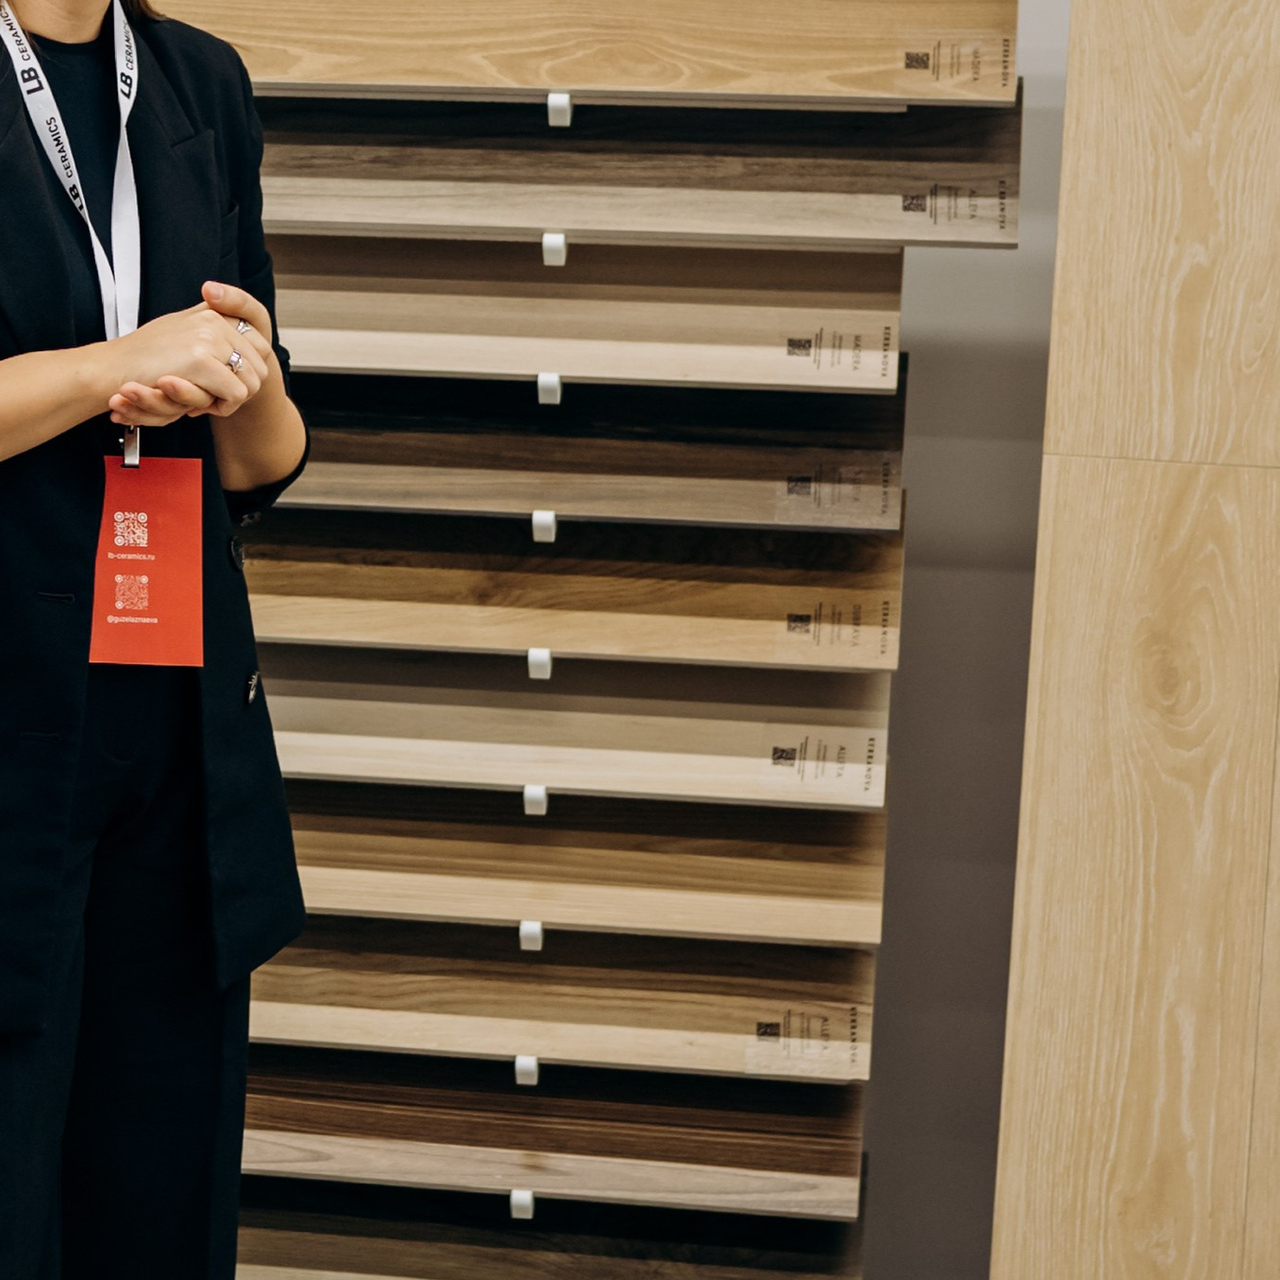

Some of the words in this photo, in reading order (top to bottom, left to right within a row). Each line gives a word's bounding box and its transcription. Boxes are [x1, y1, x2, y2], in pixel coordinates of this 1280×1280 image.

[20, 66, 45, 95] LB
[120, 72, 133, 100] LB
[46, 116, 73, 179] CERAMICS
